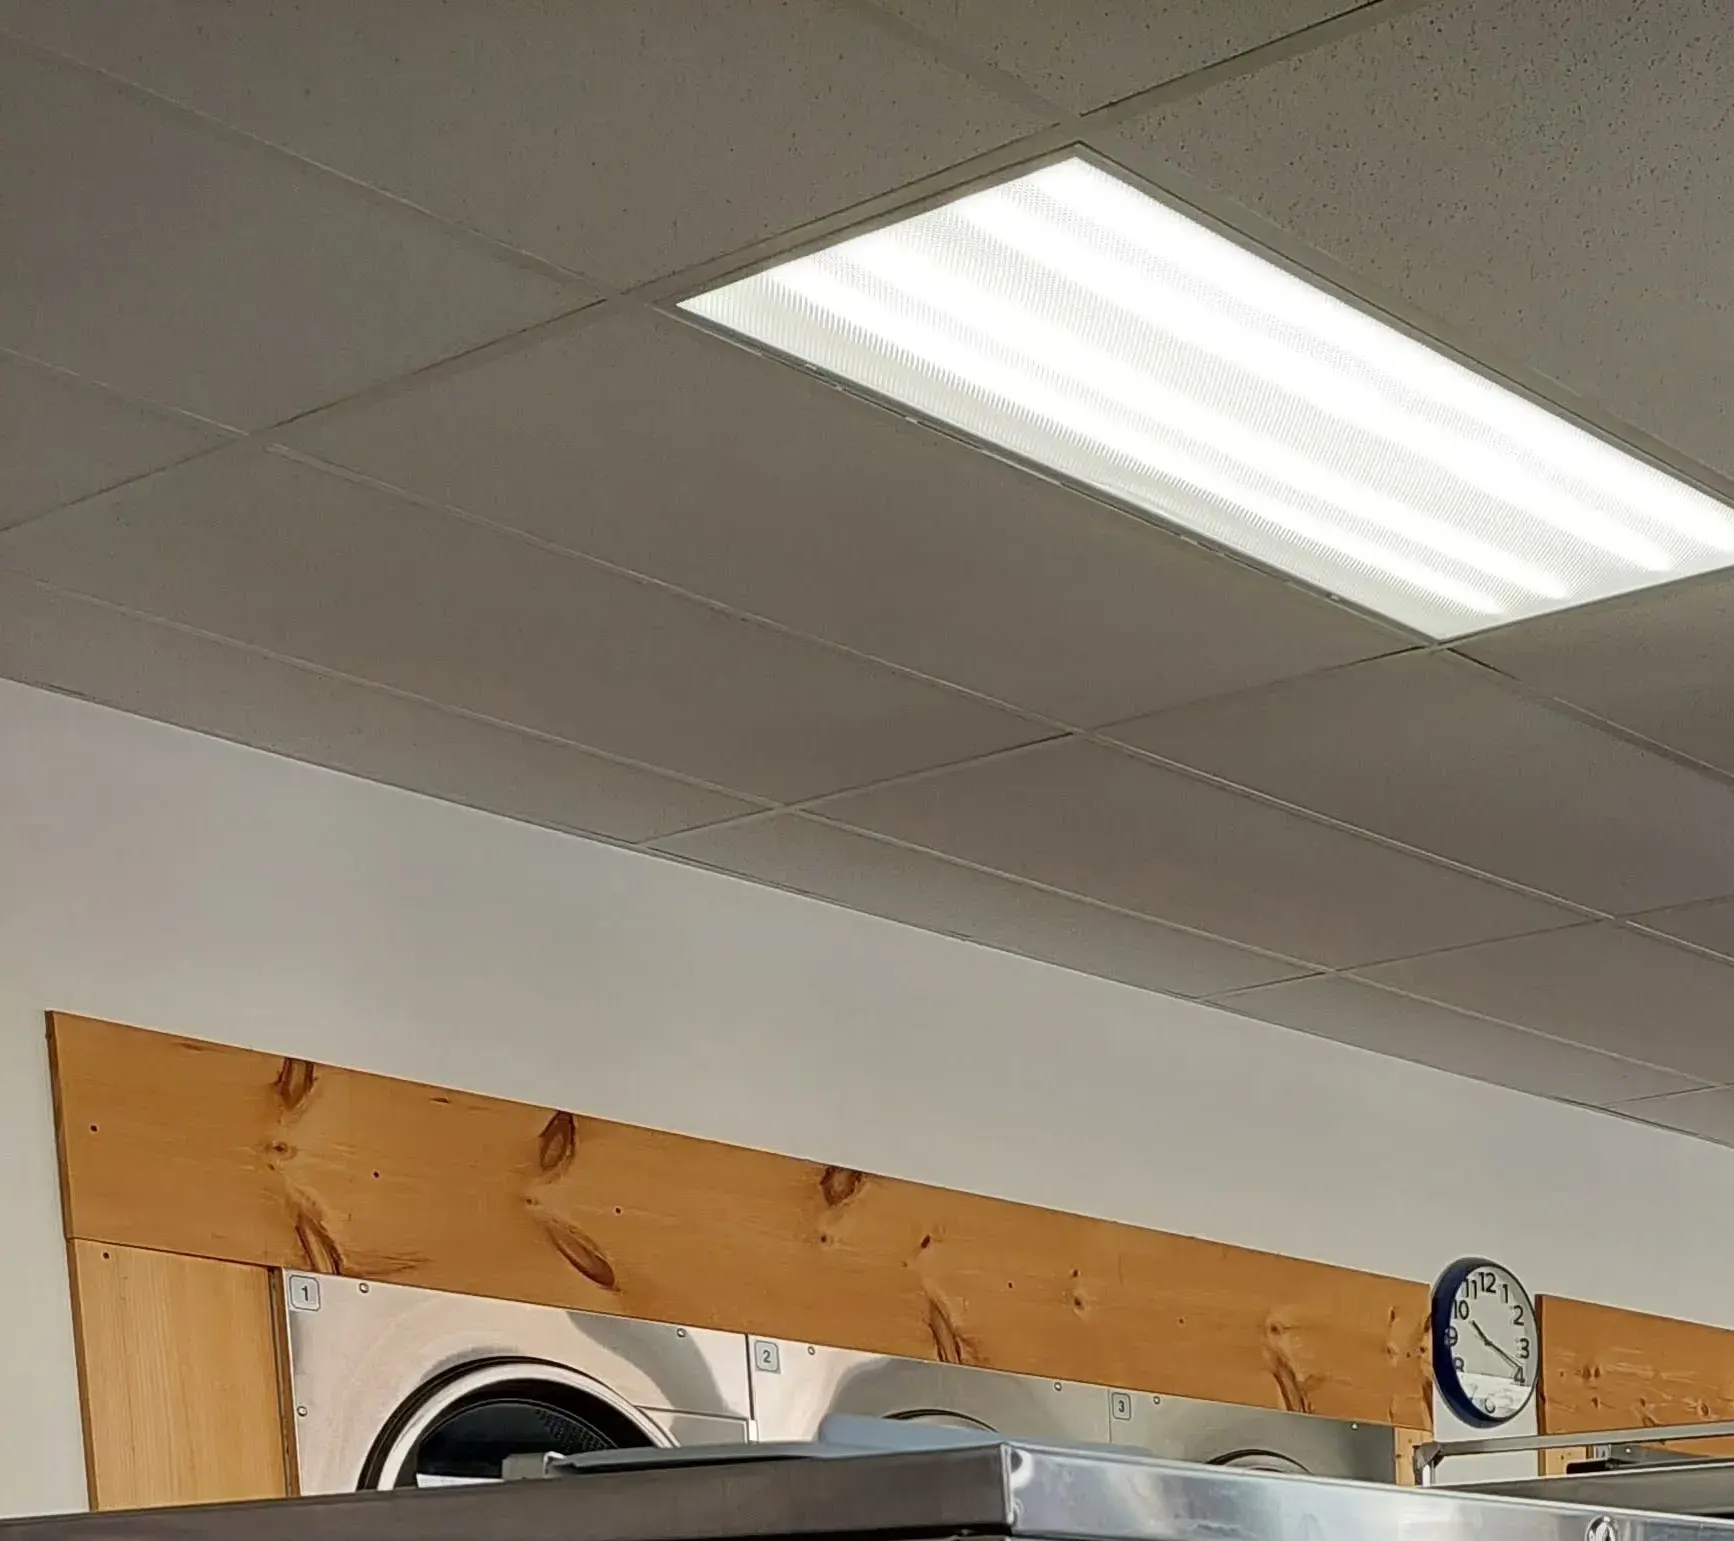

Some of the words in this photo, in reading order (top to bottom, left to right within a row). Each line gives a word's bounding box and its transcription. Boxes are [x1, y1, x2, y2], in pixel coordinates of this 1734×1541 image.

[1465, 1278, 1477, 1299] 11
[1479, 1272, 1496, 1293] 12
[301, 1285, 308, 1301] 1
[1502, 1284, 1508, 1303] 1
[1453, 1300, 1469, 1320] 10
[1513, 1305, 1524, 1326] 2
[1445, 1326, 1458, 1347] 9
[763, 1350, 771, 1363] 2
[1519, 1338, 1530, 1358] 3
[1513, 1366, 1525, 1383] 4
[1119, 1400, 1125, 1412] 3
